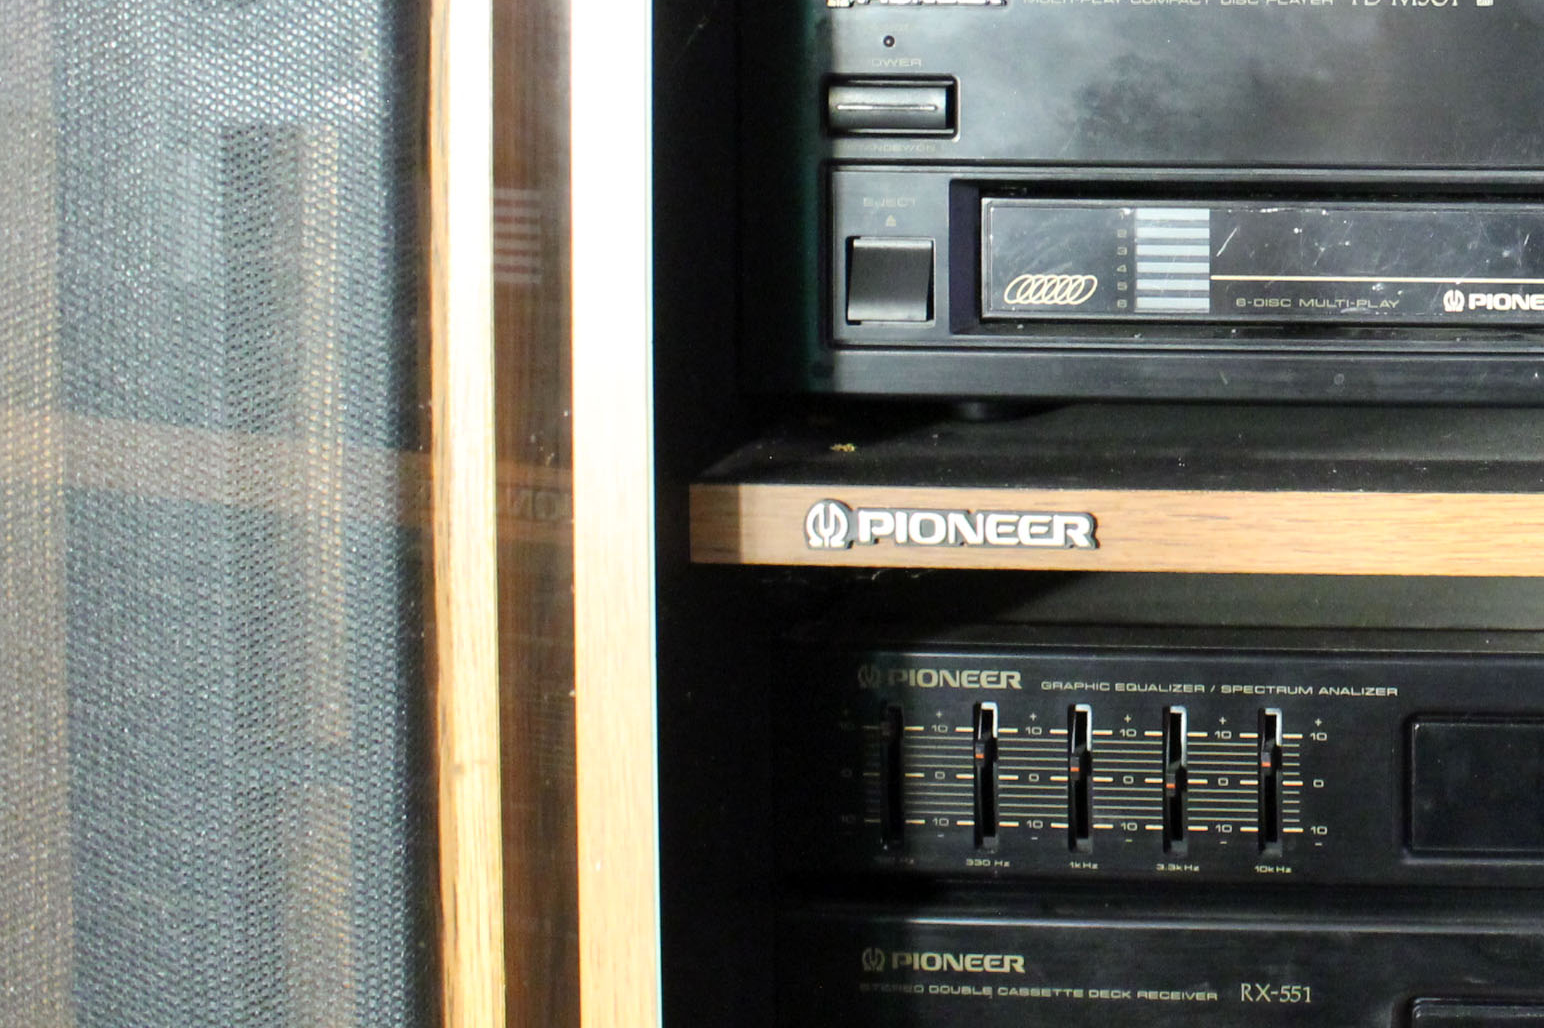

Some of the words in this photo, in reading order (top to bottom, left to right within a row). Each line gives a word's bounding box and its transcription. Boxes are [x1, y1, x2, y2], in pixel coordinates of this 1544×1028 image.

[862, 58, 922, 68] OWER
[1236, 297, 1291, 310] 6-DISC
[1299, 297, 1400, 310] MULTI-PLAY
[858, 511, 1093, 548] PIONEER
[888, 671, 1021, 689] PIONEER
[1041, 682, 1110, 692] GRAPHIC
[1115, 683, 1205, 693] EQUALIZER
[1221, 685, 1313, 695] SPECTRUM
[1026, 727, 1042, 735] 10
[1310, 733, 1327, 741] 10
[891, 953, 1026, 973] PIONEER
[929, 985, 992, 996] DOUBLE
[997, 987, 1084, 997] CASSETTE
[1089, 989, 1132, 999] DECK
[1137, 991, 1218, 1001] RECEIVER
[1241, 982, 1312, 1004] RX-551
